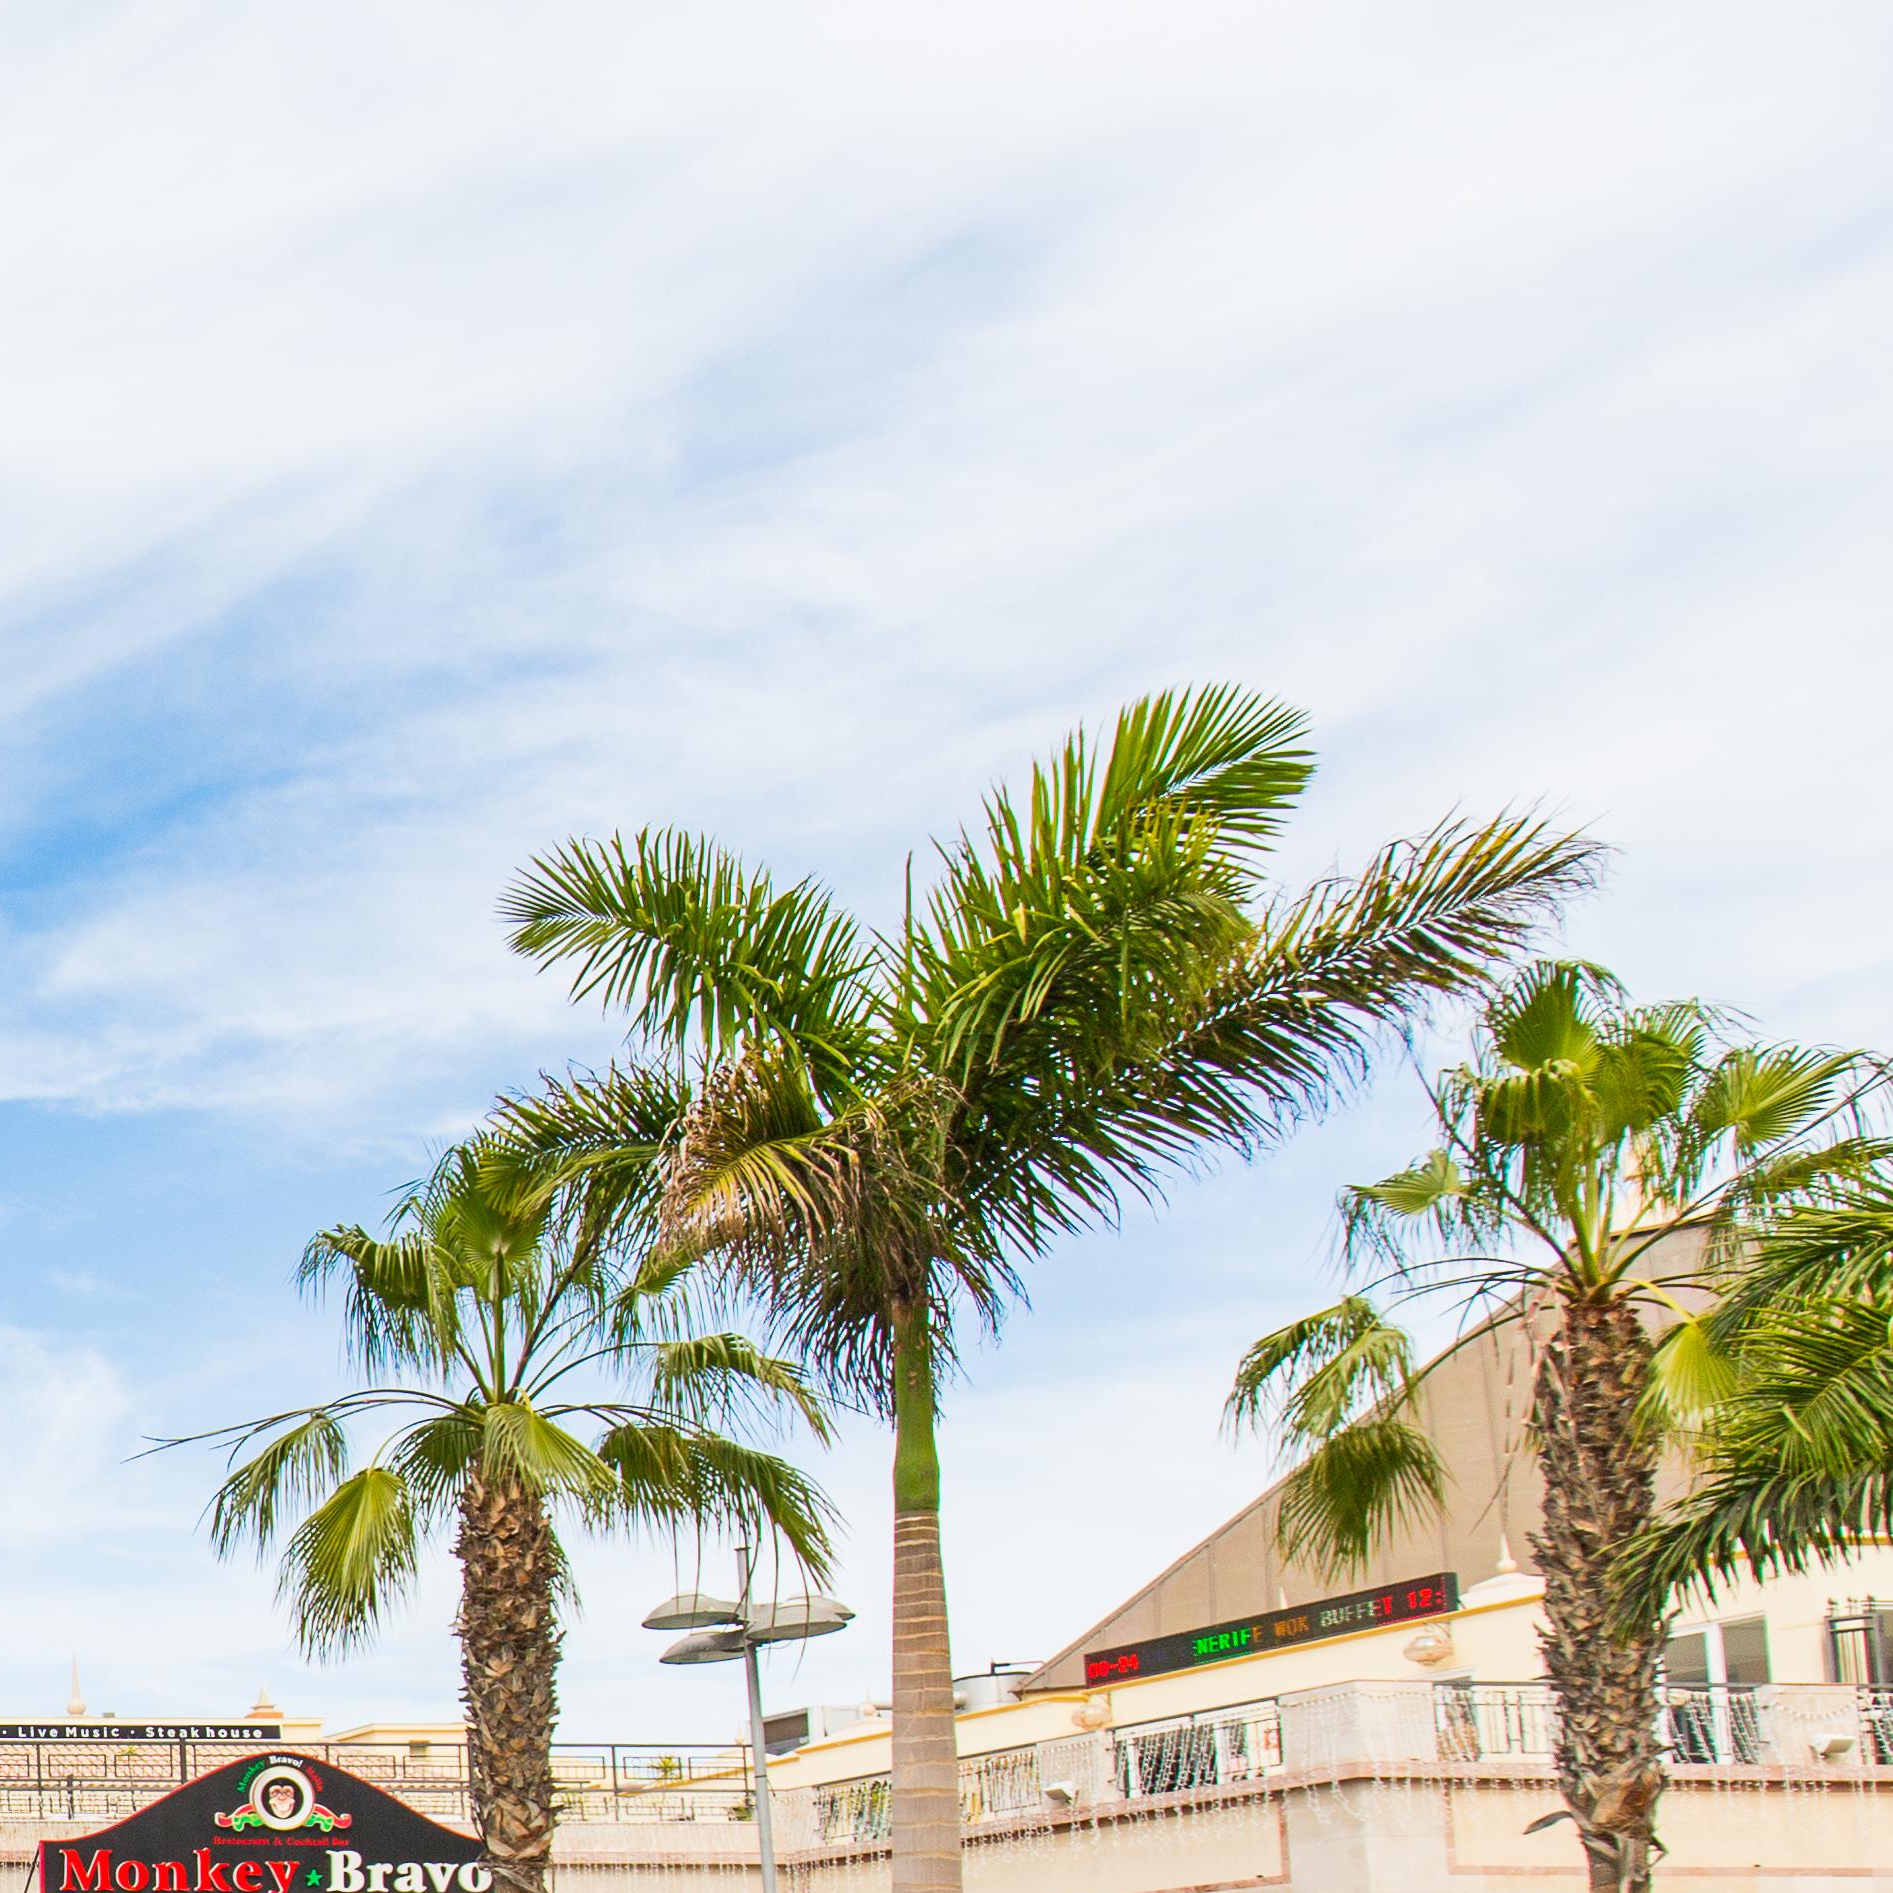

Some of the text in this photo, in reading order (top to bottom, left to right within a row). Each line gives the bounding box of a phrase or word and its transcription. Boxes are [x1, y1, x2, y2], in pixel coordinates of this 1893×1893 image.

[18, 1726, 59, 1738] Live
[65, 1726, 121, 1738] Music
[269, 1756, 304, 1768] Bravo!
